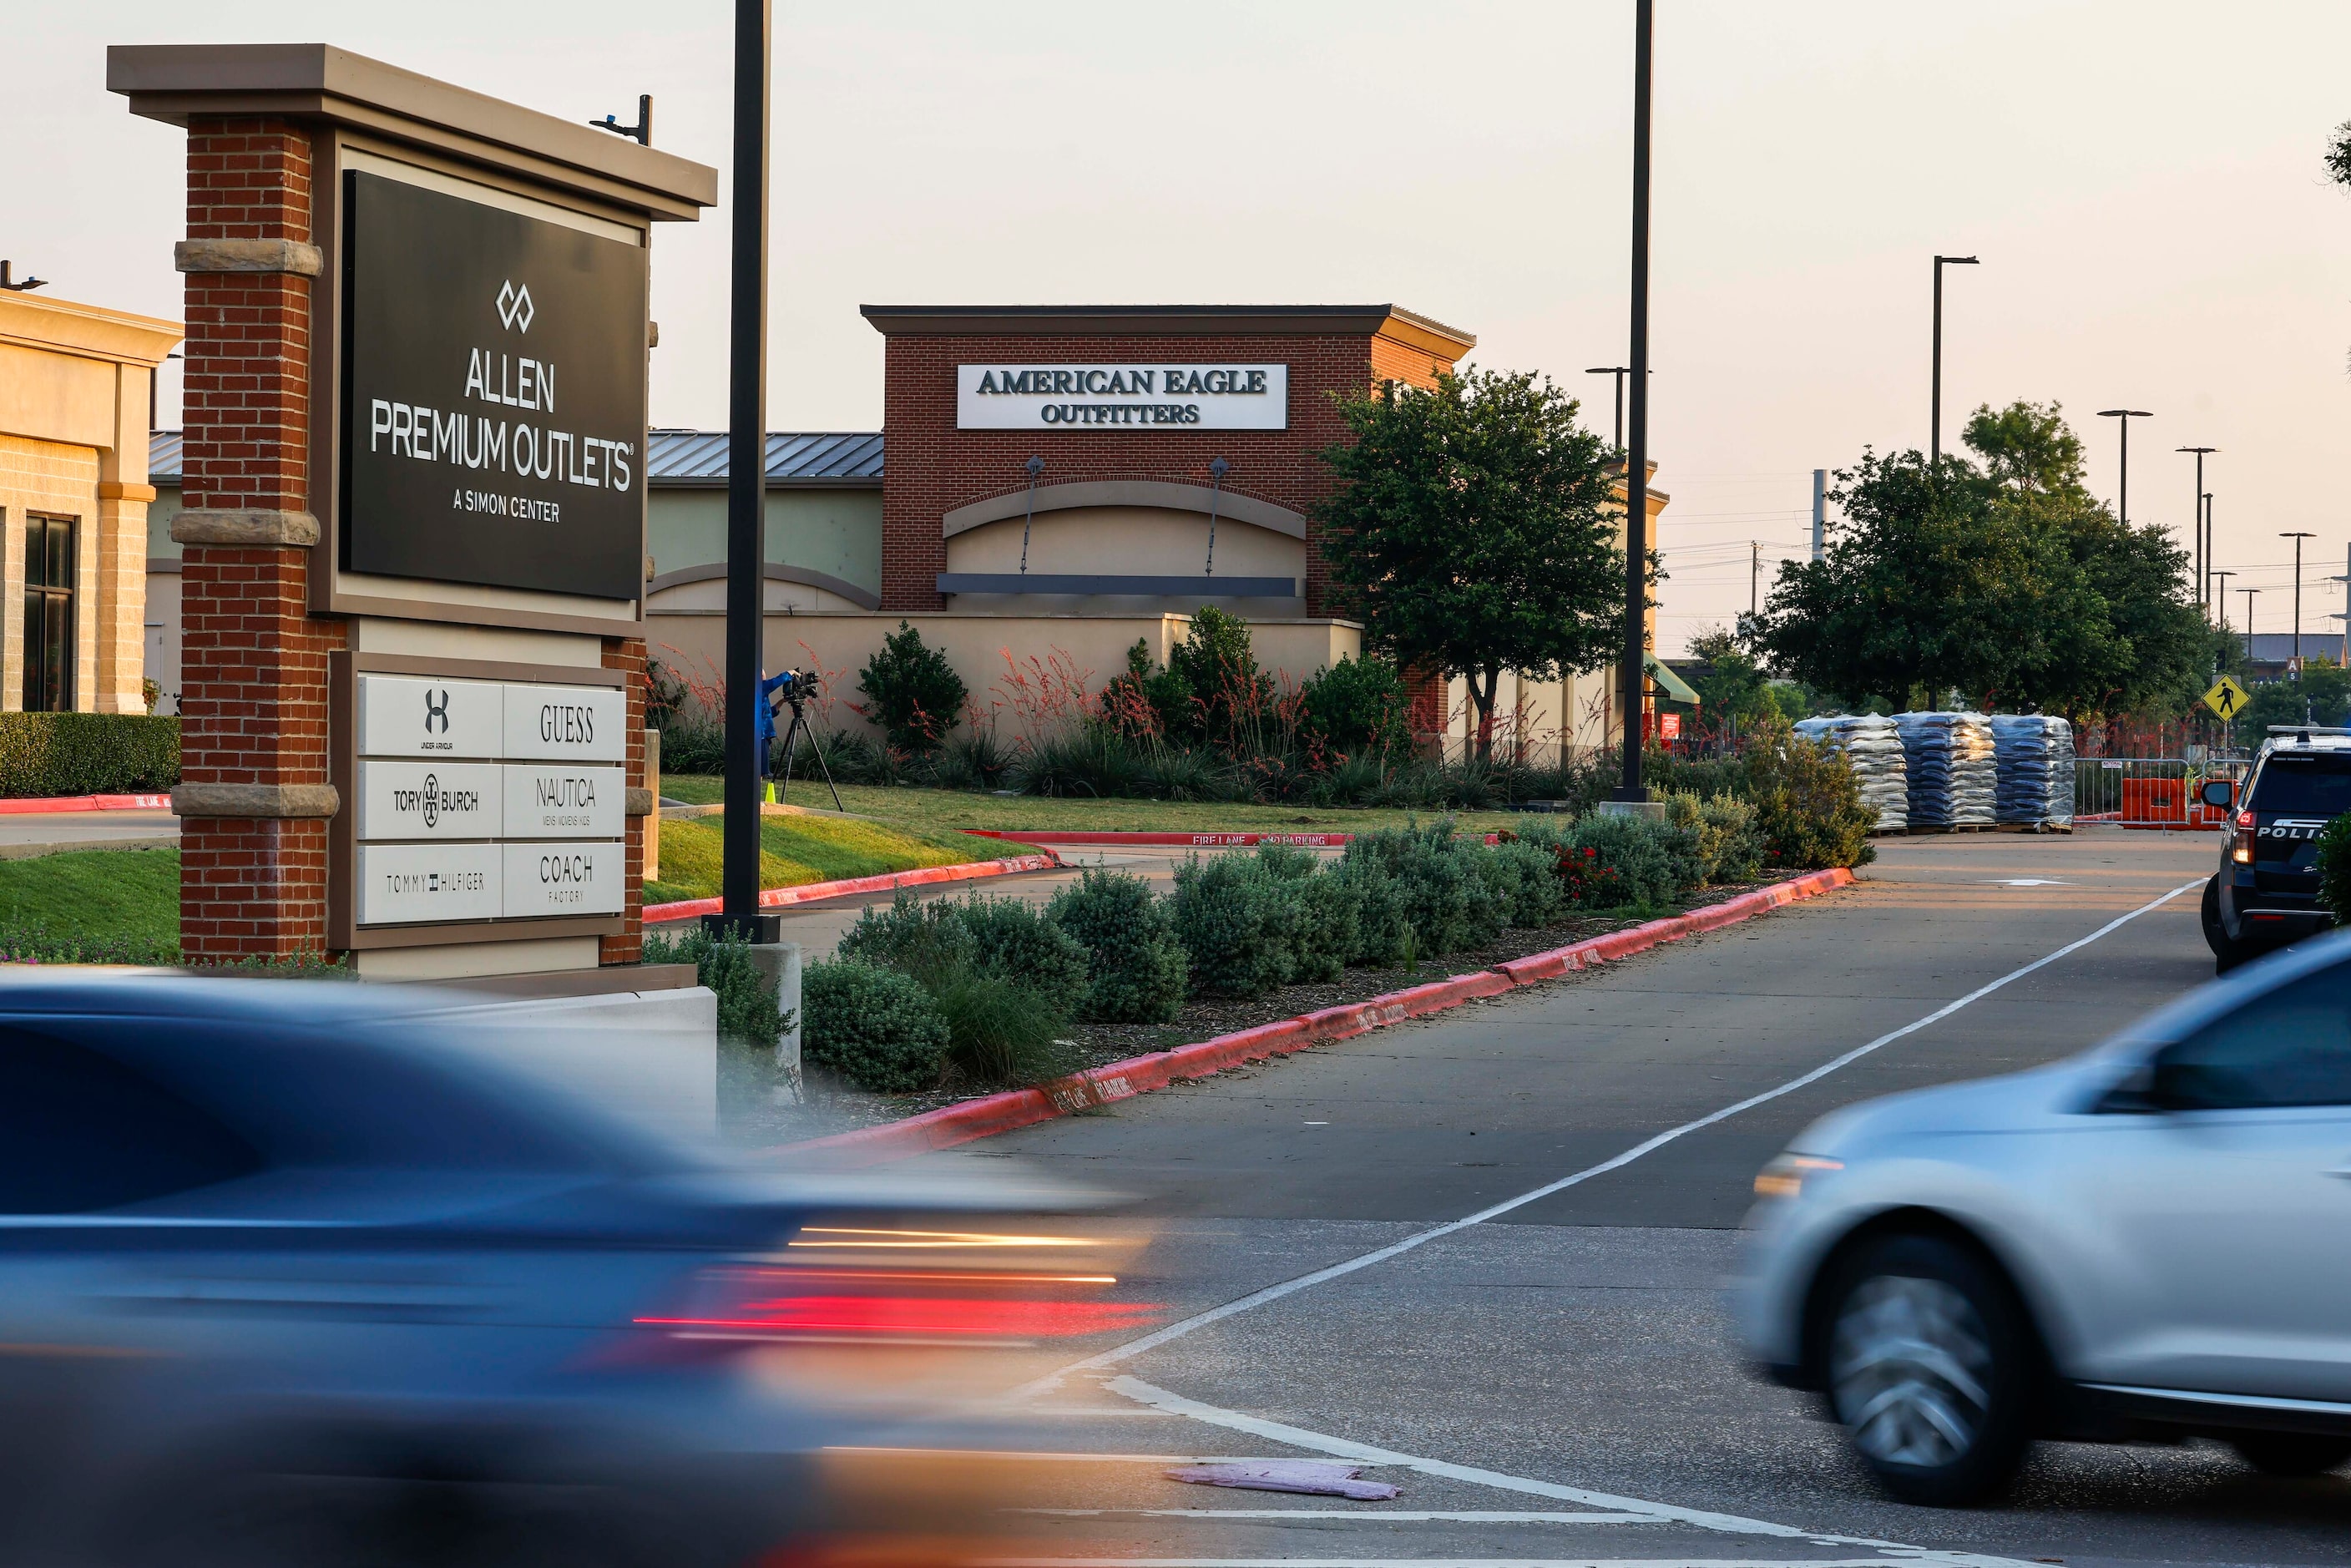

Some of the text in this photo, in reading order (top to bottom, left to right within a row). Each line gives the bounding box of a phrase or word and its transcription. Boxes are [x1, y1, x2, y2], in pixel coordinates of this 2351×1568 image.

[463, 346, 555, 413] ALLEN
[975, 369, 1267, 395] AMERICAN EAGLE
[1040, 403, 1201, 424] OUTFITTERS
[371, 398, 507, 473] PREMIUM
[453, 488, 560, 524] A SIMON CENTER
[2288, 660, 2298, 671] A
[2290, 672, 2296, 680] 5
[540, 704, 594, 744] GUESS
[421, 741, 453, 751] UNDER ARMOUR
[394, 790, 478, 812] TORY BURCH
[536, 777, 596, 807] NAUTICA
[2257, 827, 2330, 840] POLI
[540, 855, 593, 883] COACH
[387, 873, 484, 893] TOMMY HILFIGER
[549, 890, 584, 903] FACTORY
